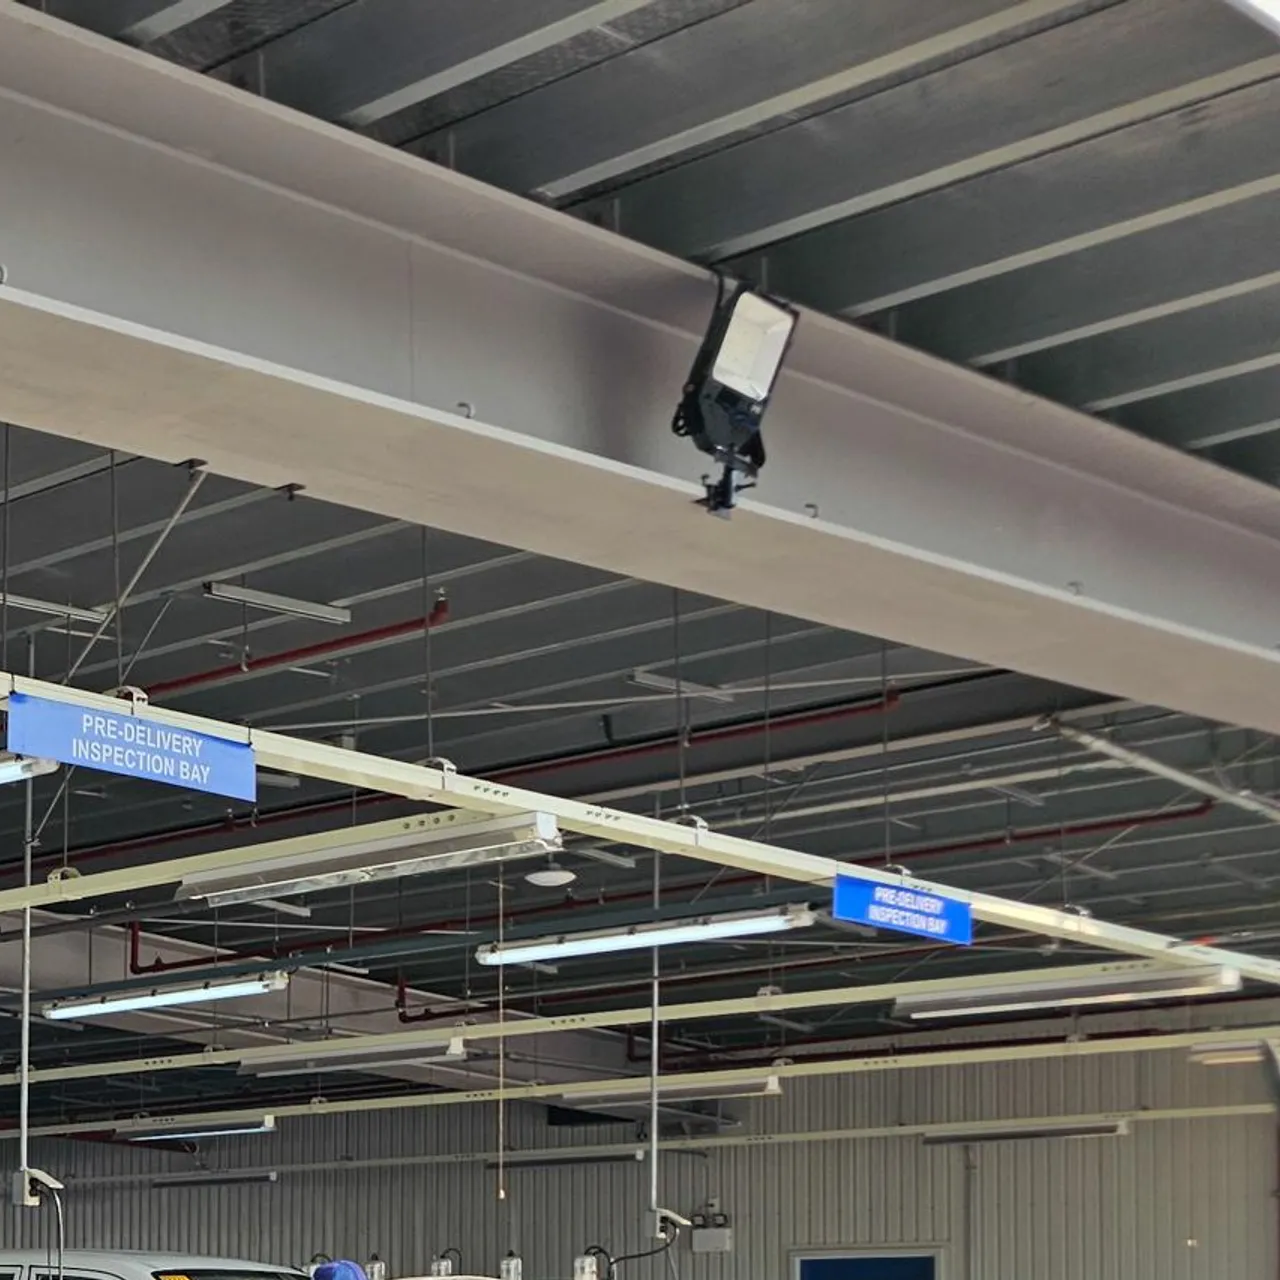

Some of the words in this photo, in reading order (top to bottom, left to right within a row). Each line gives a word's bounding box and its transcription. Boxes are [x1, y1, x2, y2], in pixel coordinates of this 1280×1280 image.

[82, 714, 204, 758] PRE-DELIVERY
[72, 738, 176, 778] INSPECTION
[179, 762, 212, 785] BAY
